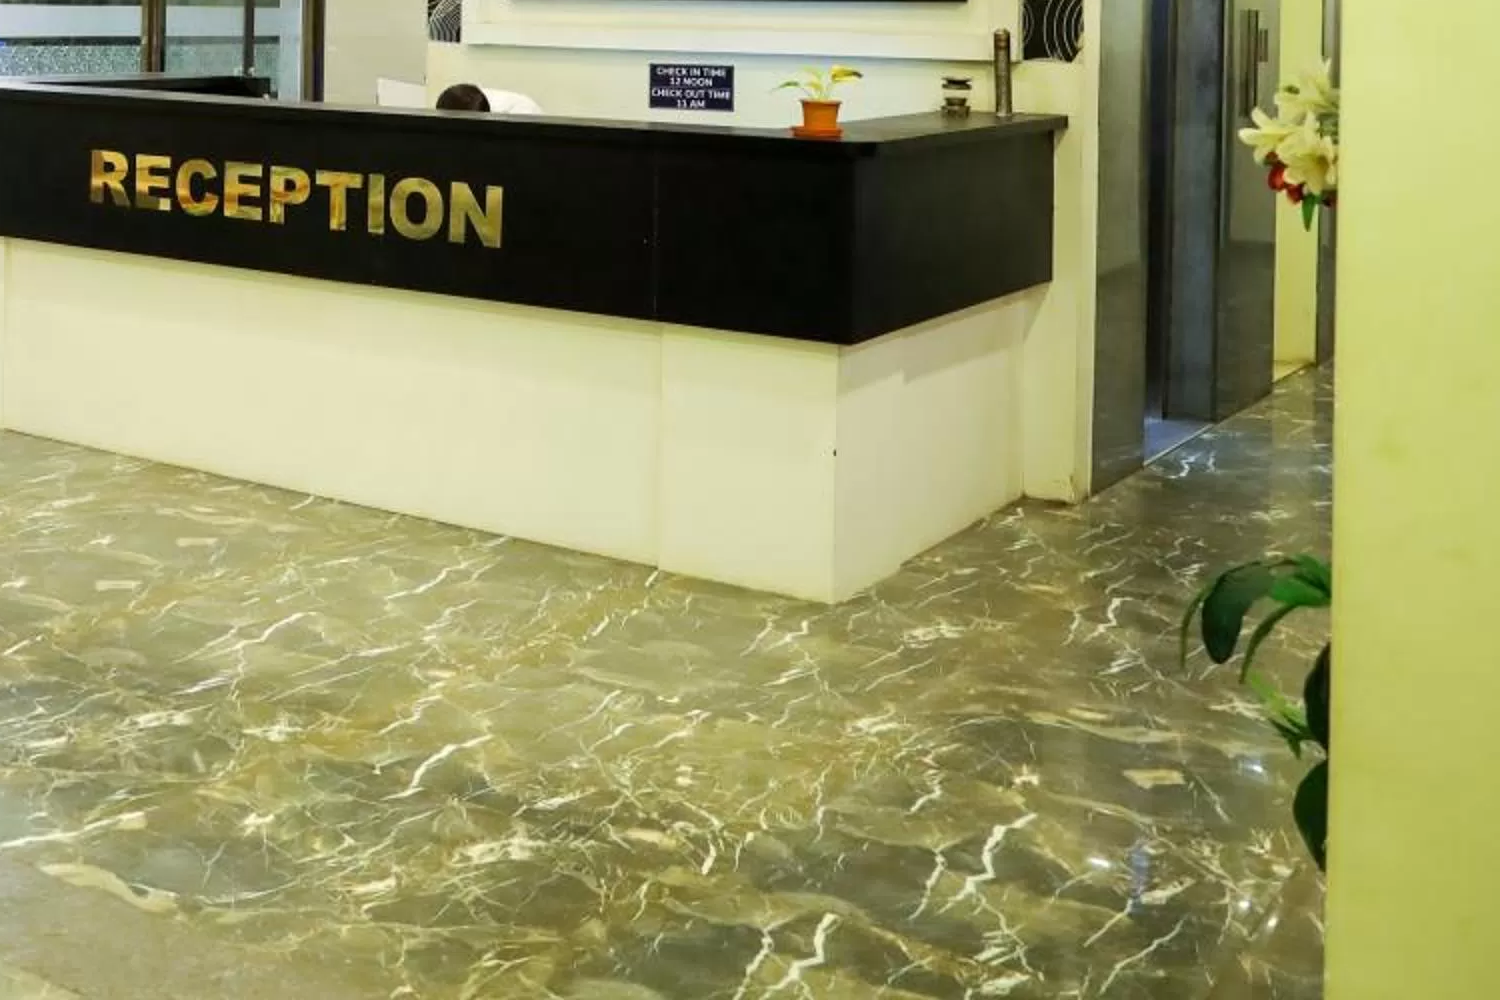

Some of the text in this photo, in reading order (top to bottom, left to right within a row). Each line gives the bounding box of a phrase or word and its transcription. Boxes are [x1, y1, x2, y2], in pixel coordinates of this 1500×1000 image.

[656, 67, 726, 78] CHECK IN TIME
[670, 77, 713, 87] 12 NOON
[651, 87, 731, 100] CHECK OUT TIME
[690, 99, 706, 109] AM
[90, 149, 503, 248] RECEPTION
